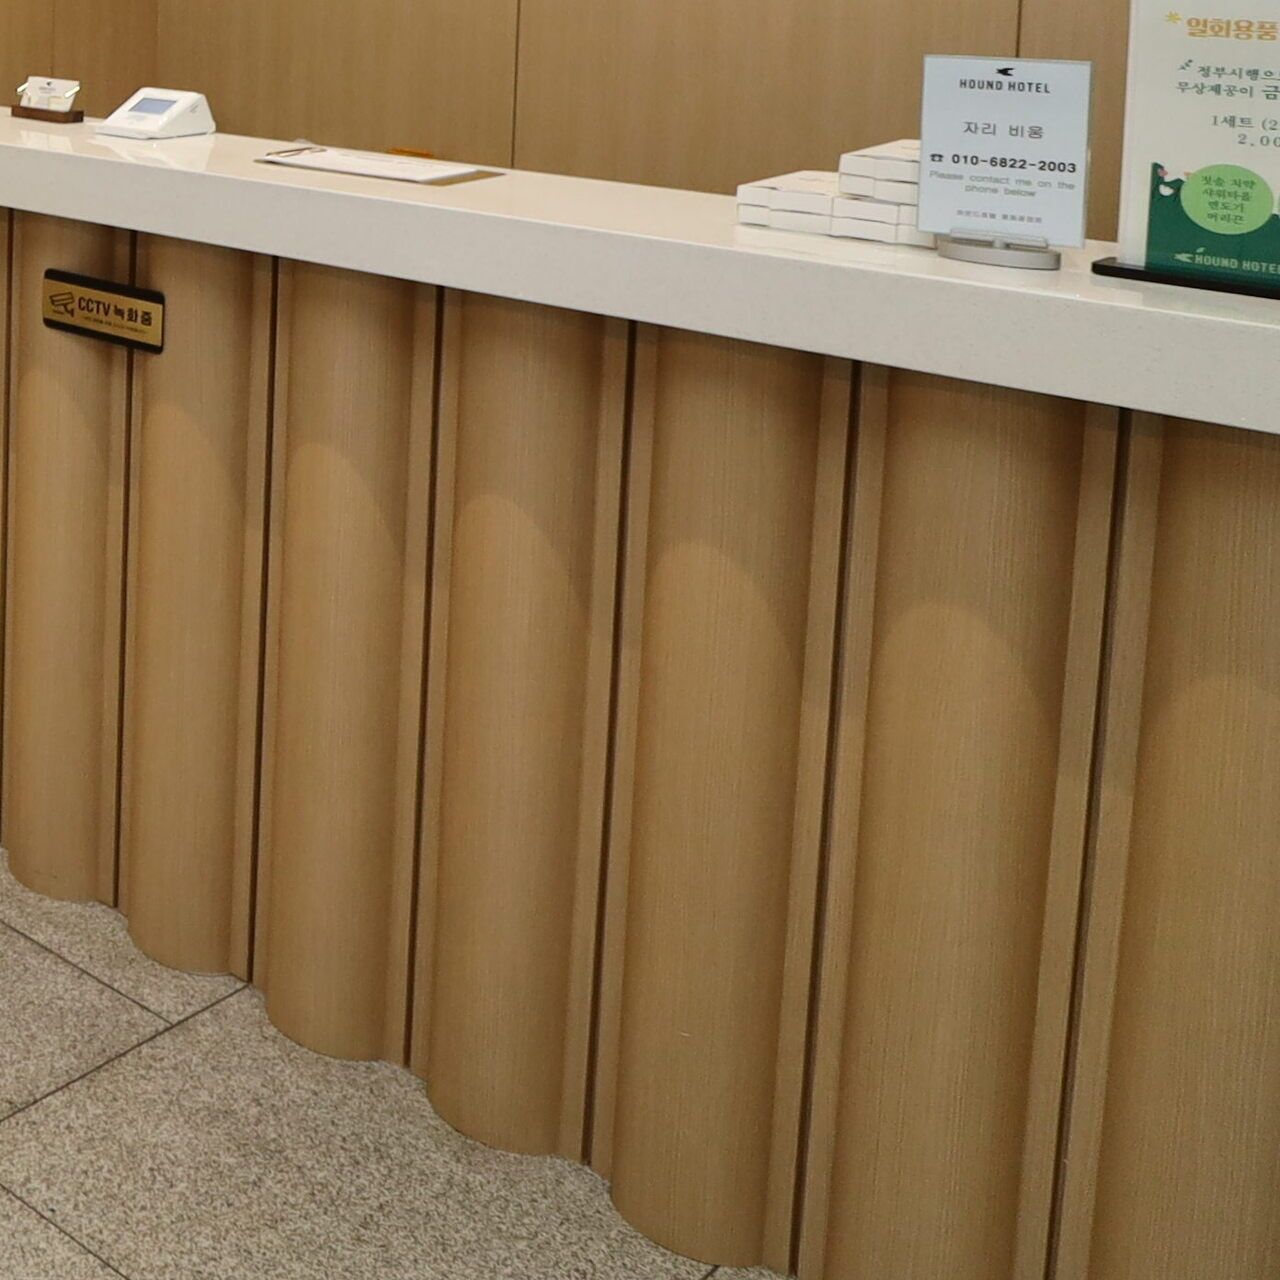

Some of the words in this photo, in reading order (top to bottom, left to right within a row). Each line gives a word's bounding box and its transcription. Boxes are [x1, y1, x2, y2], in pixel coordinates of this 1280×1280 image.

[1186, 17, 1278, 41] 일회용품
[1198, 66, 1280, 81] 정부시행으
[959, 79, 1003, 91] HOUND
[1007, 81, 1051, 93] HOTEL
[1176, 81, 1254, 98] 무상제공이
[963, 121, 997, 136] 자리
[1008, 124, 1044, 139] 비움
[1212, 115, 1254, 128] 1세트
[951, 154, 1077, 173] 010-6822-2003
[929, 171, 964, 181] Please
[969, 175, 1010, 185] contact
[1015, 179, 1032, 187] me
[1057, 182, 1075, 190] the
[964, 185, 998, 195] phone
[1004, 189, 1036, 198] below
[1195, 254, 1238, 268] HOUND
[78, 296, 111, 316] CCTV
